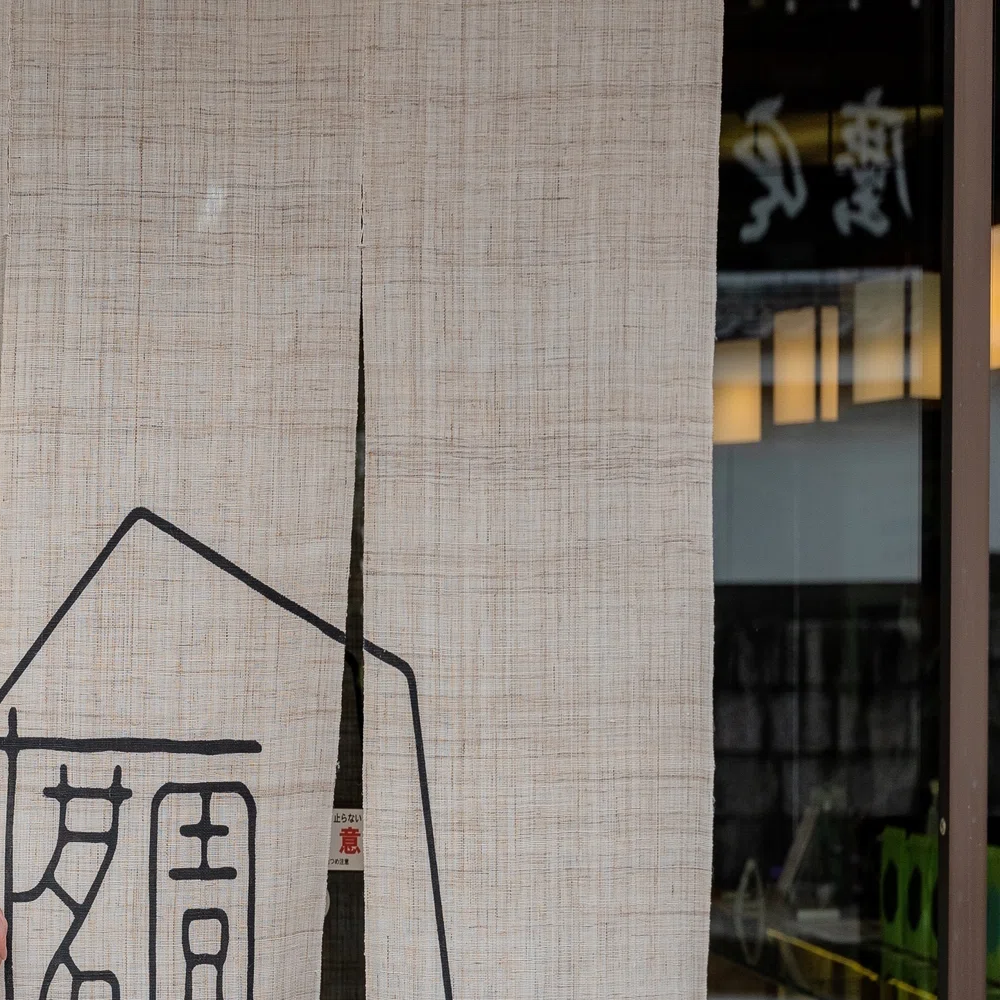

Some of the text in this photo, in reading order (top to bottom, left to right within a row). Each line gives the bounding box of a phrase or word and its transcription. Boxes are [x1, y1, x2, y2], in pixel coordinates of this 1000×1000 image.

[333, 812, 362, 823] 止らない
[339, 826, 361, 855] 意
[328, 858, 349, 866] つめ注意
